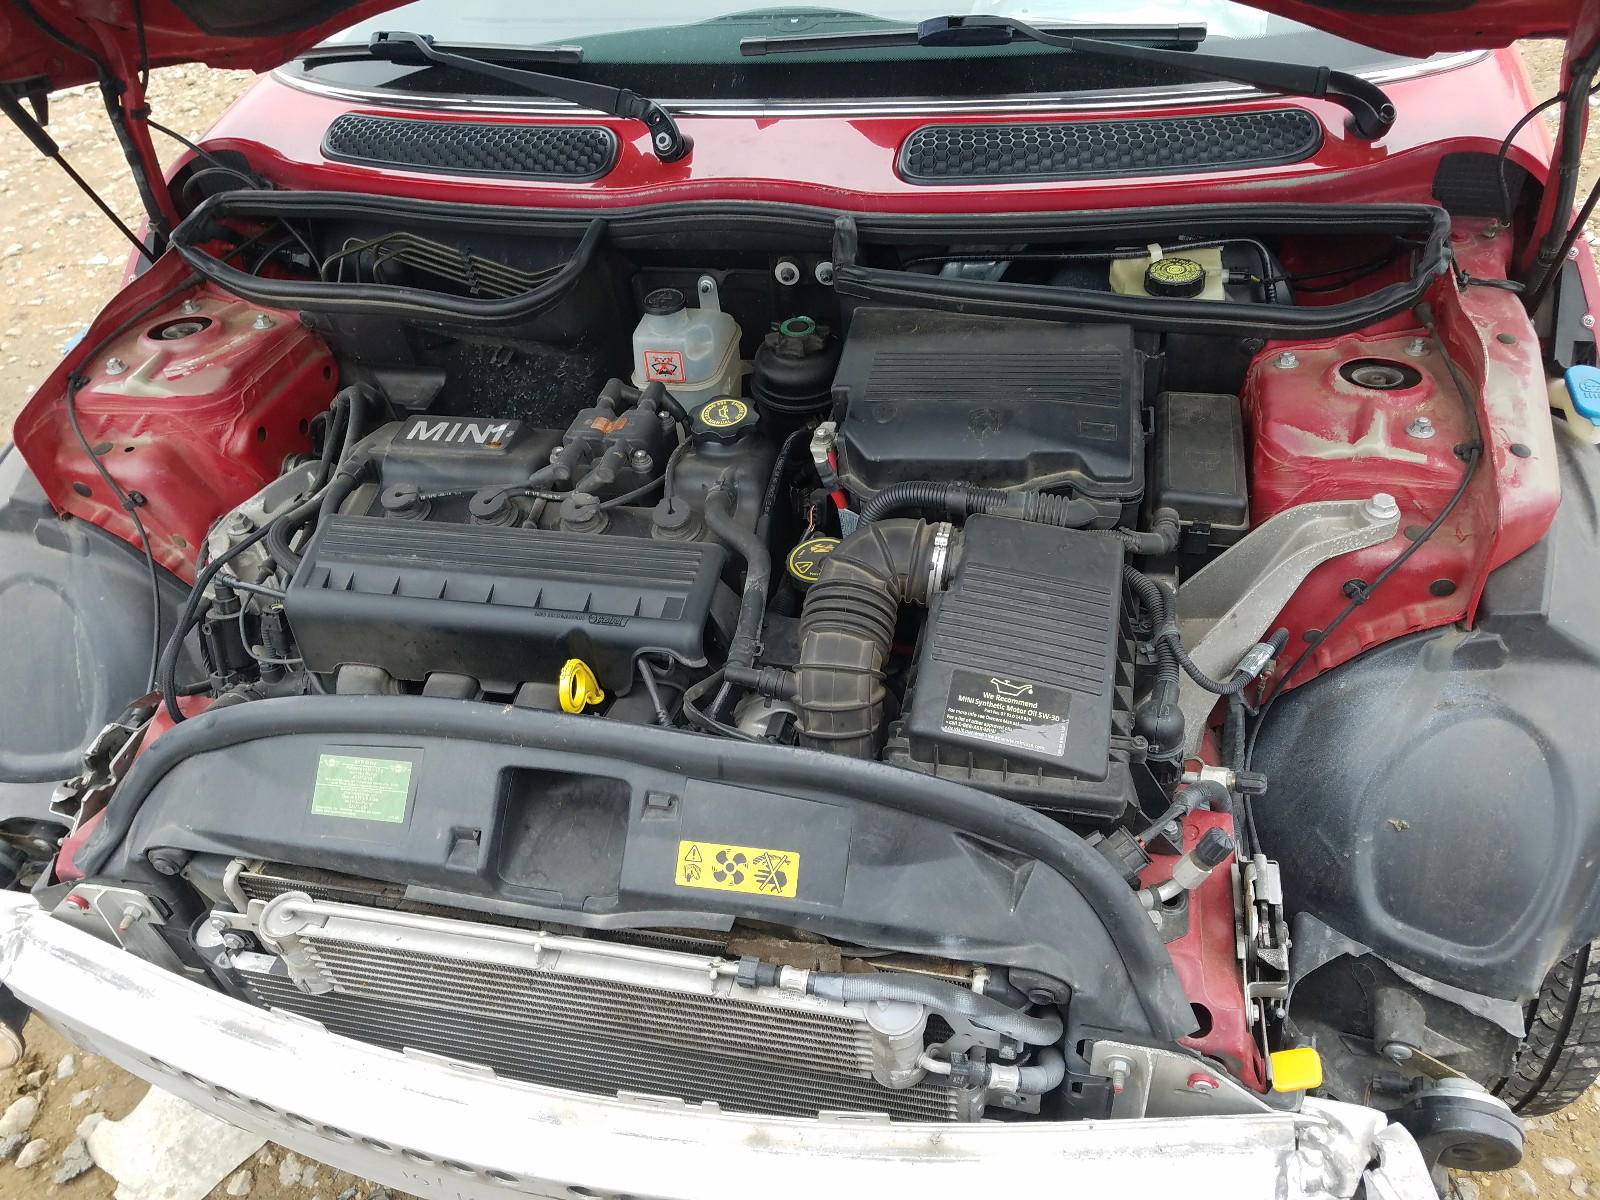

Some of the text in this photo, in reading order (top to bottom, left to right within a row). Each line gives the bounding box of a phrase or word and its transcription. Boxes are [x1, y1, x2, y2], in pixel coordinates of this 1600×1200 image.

[958, 694, 1060, 722] MINI Synthetic Motor Oil 5W-30
[983, 691, 1038, 709] We Recommend
